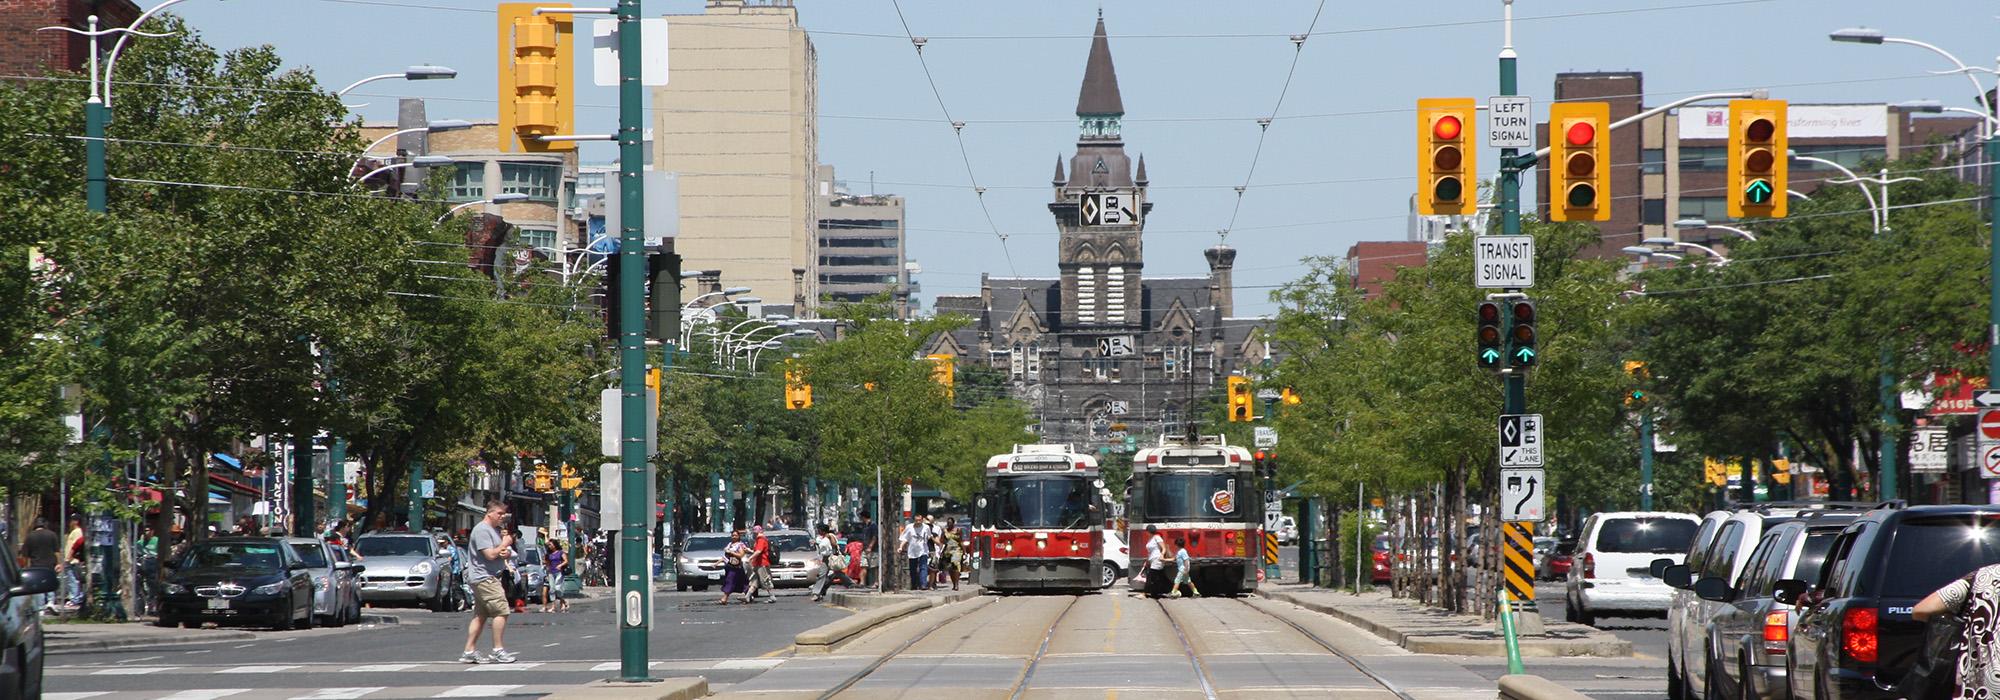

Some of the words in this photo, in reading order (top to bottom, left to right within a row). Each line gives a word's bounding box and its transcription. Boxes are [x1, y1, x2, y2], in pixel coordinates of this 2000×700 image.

[1495, 103, 1525, 113] LEFT
[1494, 117, 1527, 127] TURN
[1787, 117, 1838, 129] nsforming
[1491, 131, 1529, 141] SIGNAL
[1480, 243, 1529, 259] TRANSIT
[1483, 264, 1526, 280] SIGNAL
[1888, 606, 1914, 614] PILO
